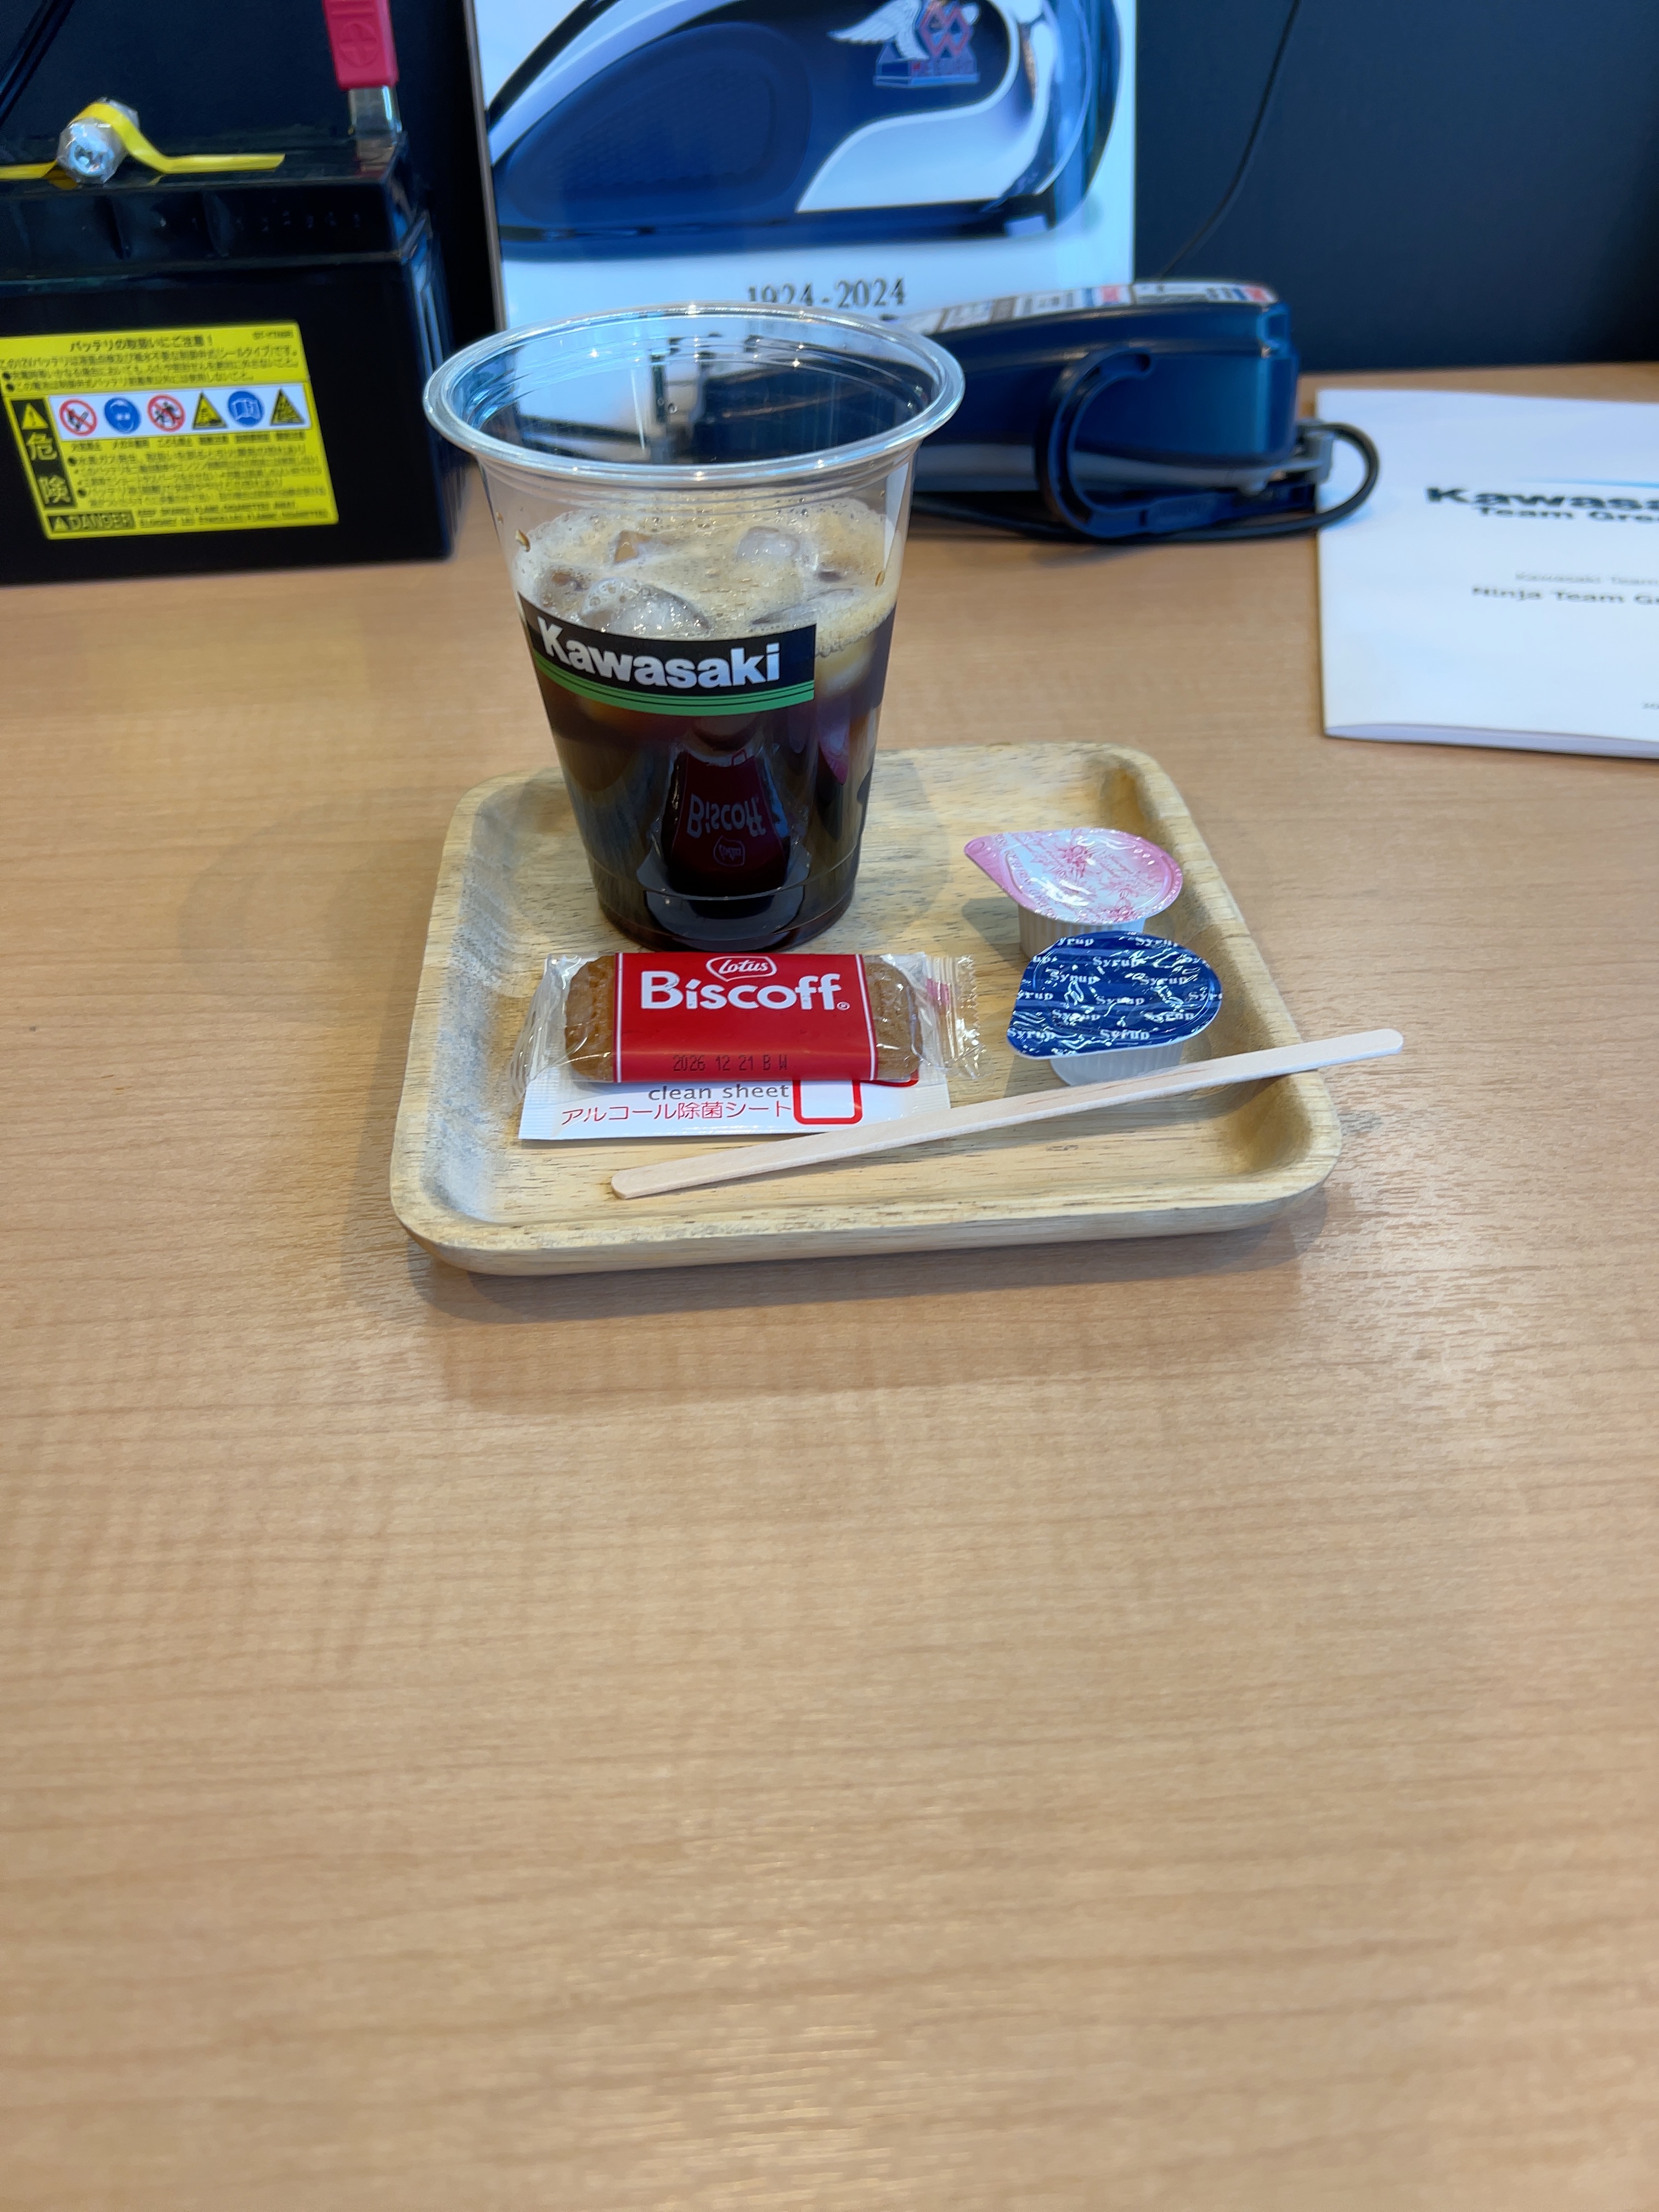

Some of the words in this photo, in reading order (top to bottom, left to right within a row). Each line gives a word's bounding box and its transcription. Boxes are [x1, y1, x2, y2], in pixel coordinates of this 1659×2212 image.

[1479, 507, 1575, 519] Team
[1589, 511, 1659, 524] Gre
[1472, 586, 1542, 601] Ninja
[1555, 591, 1626, 604] Team
[537, 616, 780, 689] Kawasaki
[1056, 936, 1095, 947] yrup
[718, 958, 769, 975] Lotus
[641, 970, 842, 1011] Biscoff
[1016, 989, 1054, 1001] yrup
[1099, 1029, 1150, 1040] Syrup
[673, 1054, 706, 1072] 2026
[716, 1055, 731, 1071] 12
[738, 1054, 754, 1071] 21
[763, 1054, 771, 1071] B
[778, 1054, 788, 1071] W
[648, 1085, 712, 1101] clean
[722, 1083, 790, 1098] sheet
[561, 1100, 792, 1126] アルコール除菌シート
